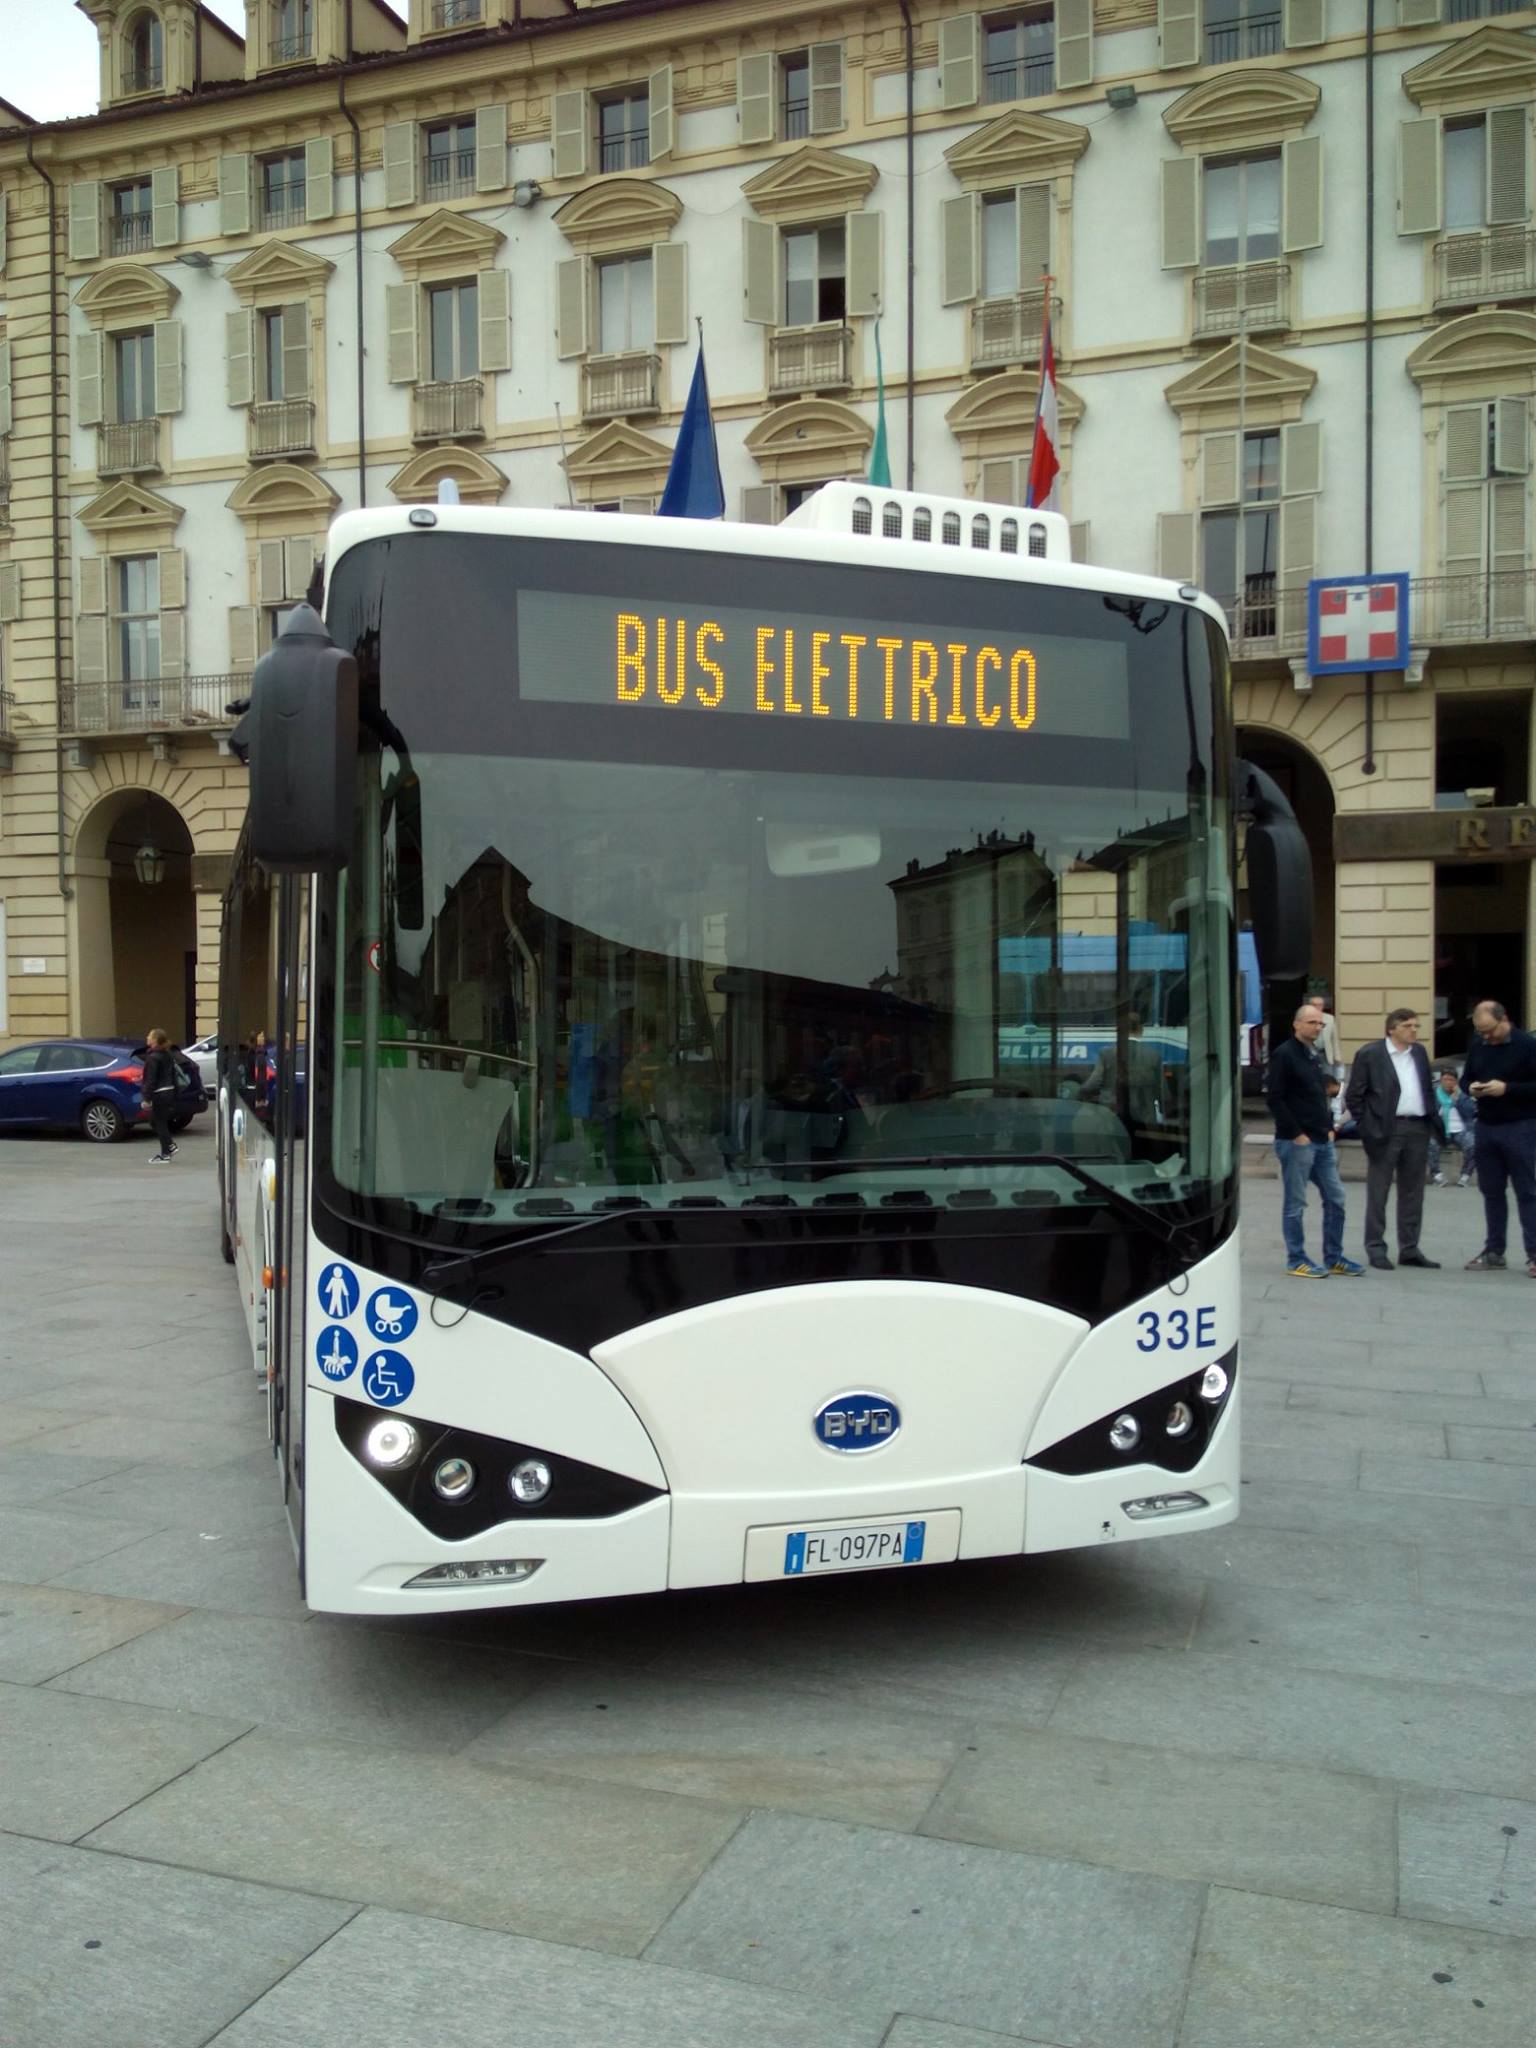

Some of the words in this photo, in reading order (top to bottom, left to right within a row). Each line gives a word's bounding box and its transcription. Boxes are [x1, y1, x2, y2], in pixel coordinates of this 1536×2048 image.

[616, 613, 724, 707] BUS
[755, 626, 1037, 730] ELETTRICO
[998, 1044, 1088, 1059] OLIZIA
[1136, 1306, 1216, 1353] 33E
[823, 1408, 892, 1438] BYD
